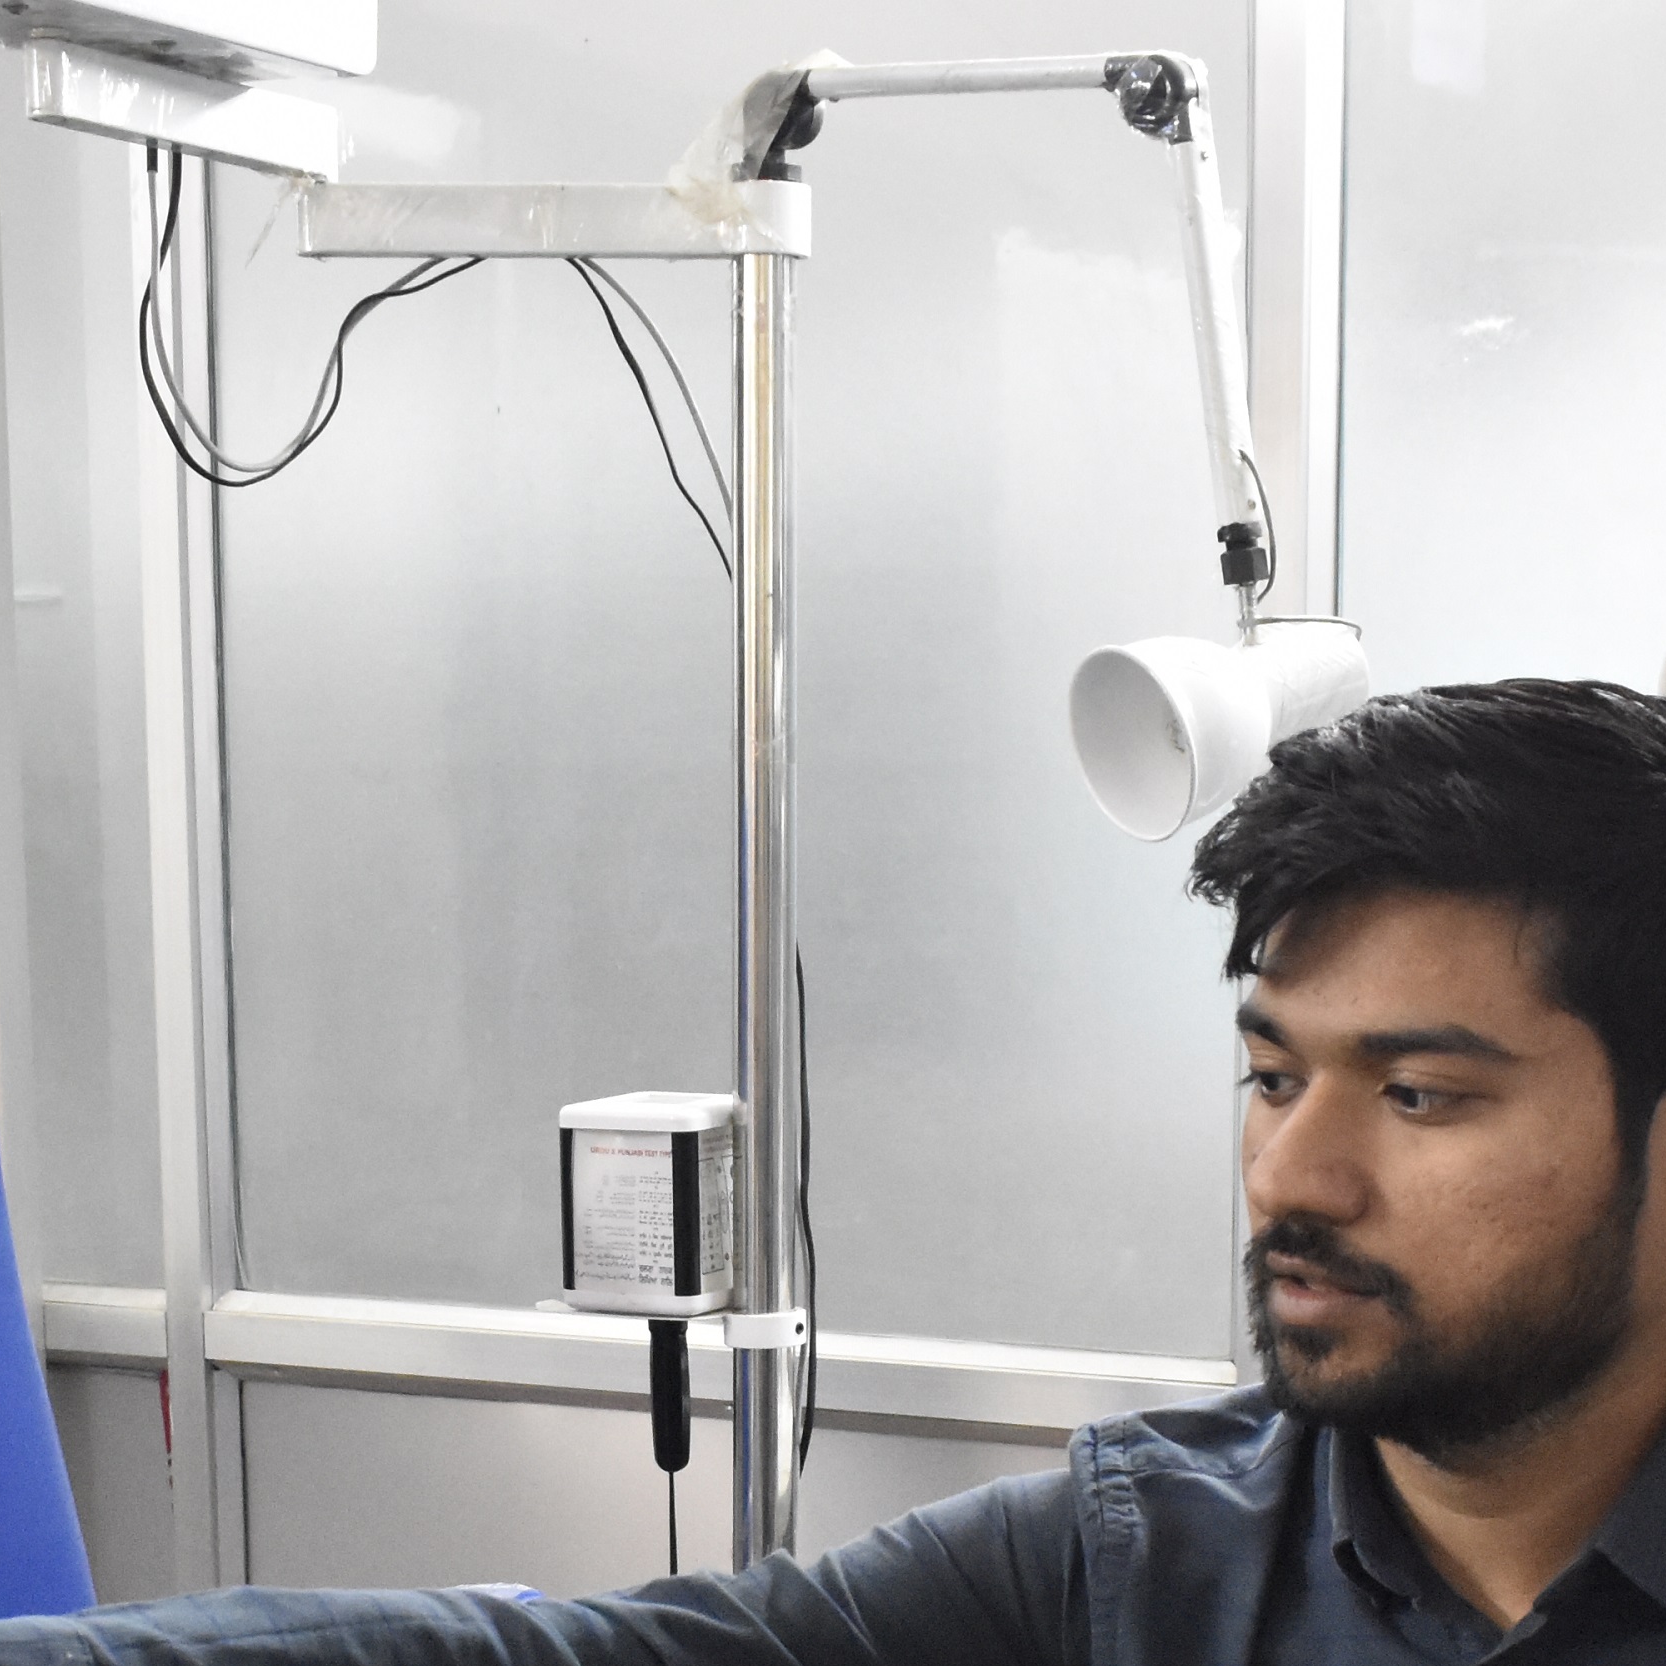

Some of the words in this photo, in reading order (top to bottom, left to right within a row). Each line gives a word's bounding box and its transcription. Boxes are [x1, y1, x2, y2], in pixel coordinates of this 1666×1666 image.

[590, 1146, 610, 1154] URDU
[618, 1148, 644, 1157] PUNJABI
[644, 1149, 658, 1158] TEST
